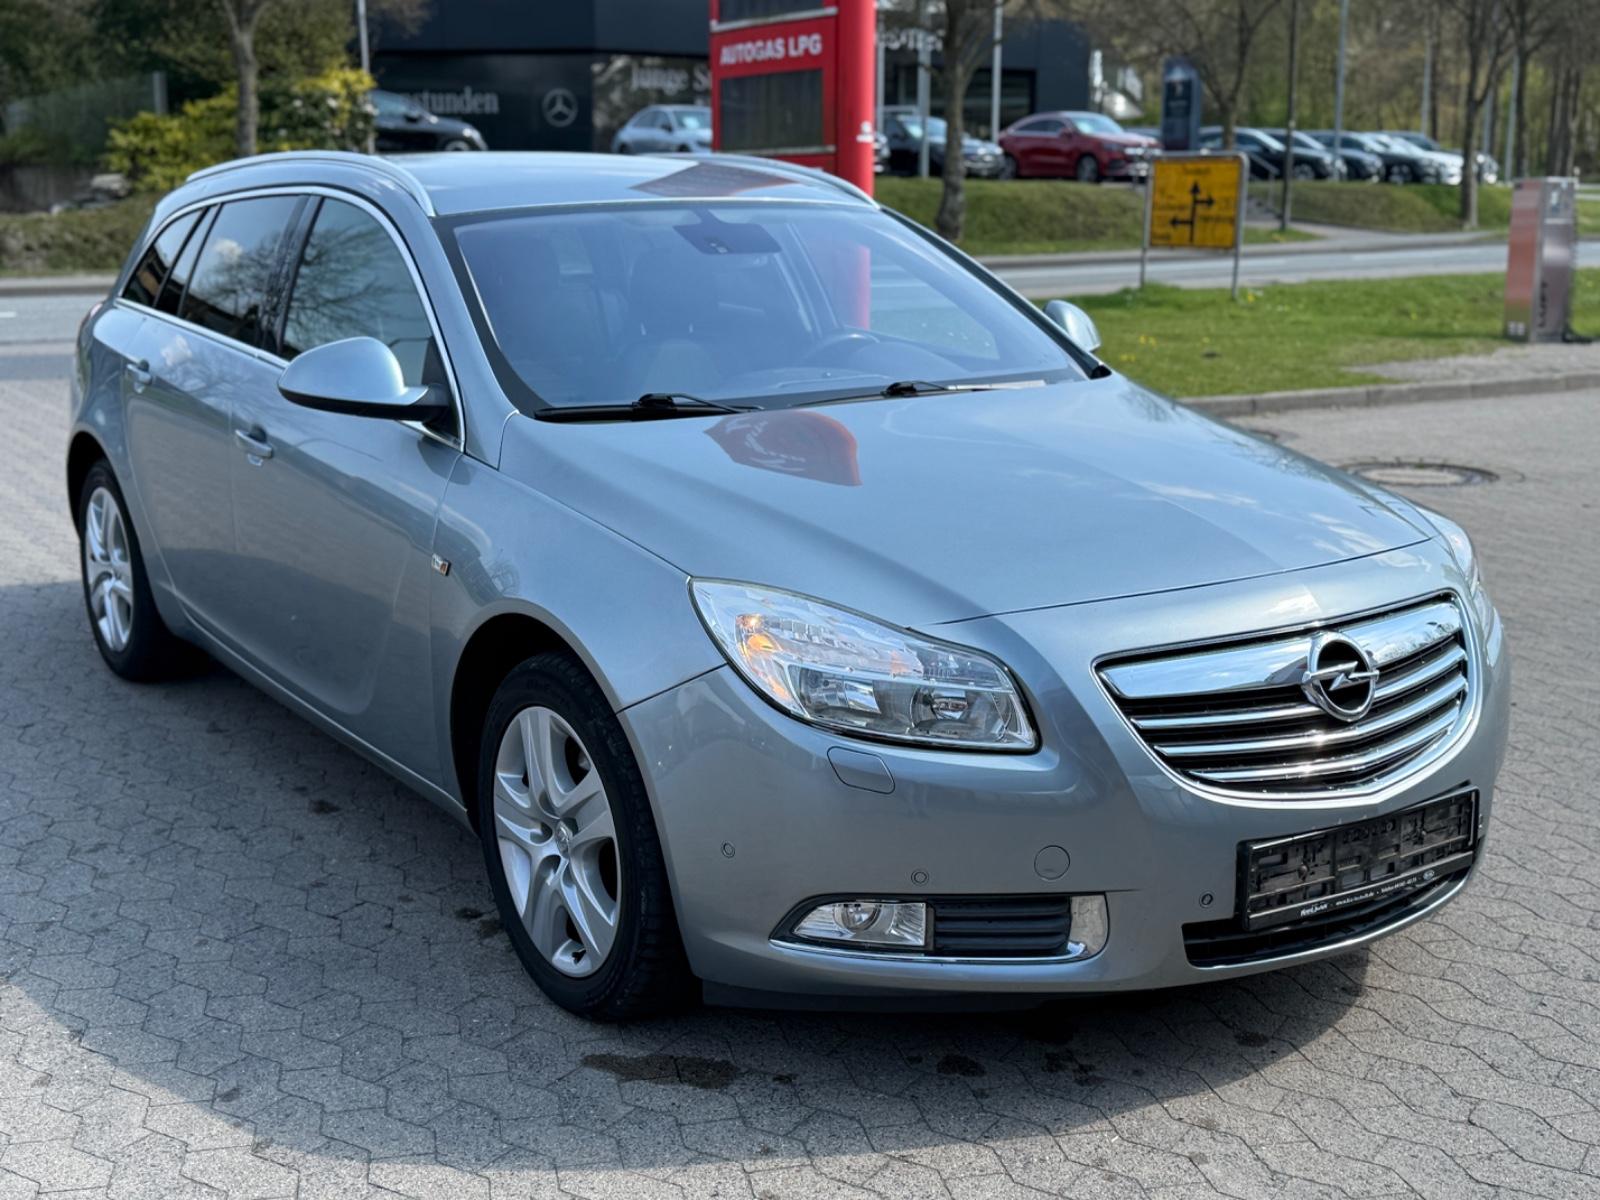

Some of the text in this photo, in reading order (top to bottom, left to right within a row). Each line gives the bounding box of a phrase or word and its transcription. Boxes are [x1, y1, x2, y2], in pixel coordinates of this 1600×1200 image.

[720, 32, 822, 66] AUTOGAS LPG
[630, 61, 688, 96] Junge
